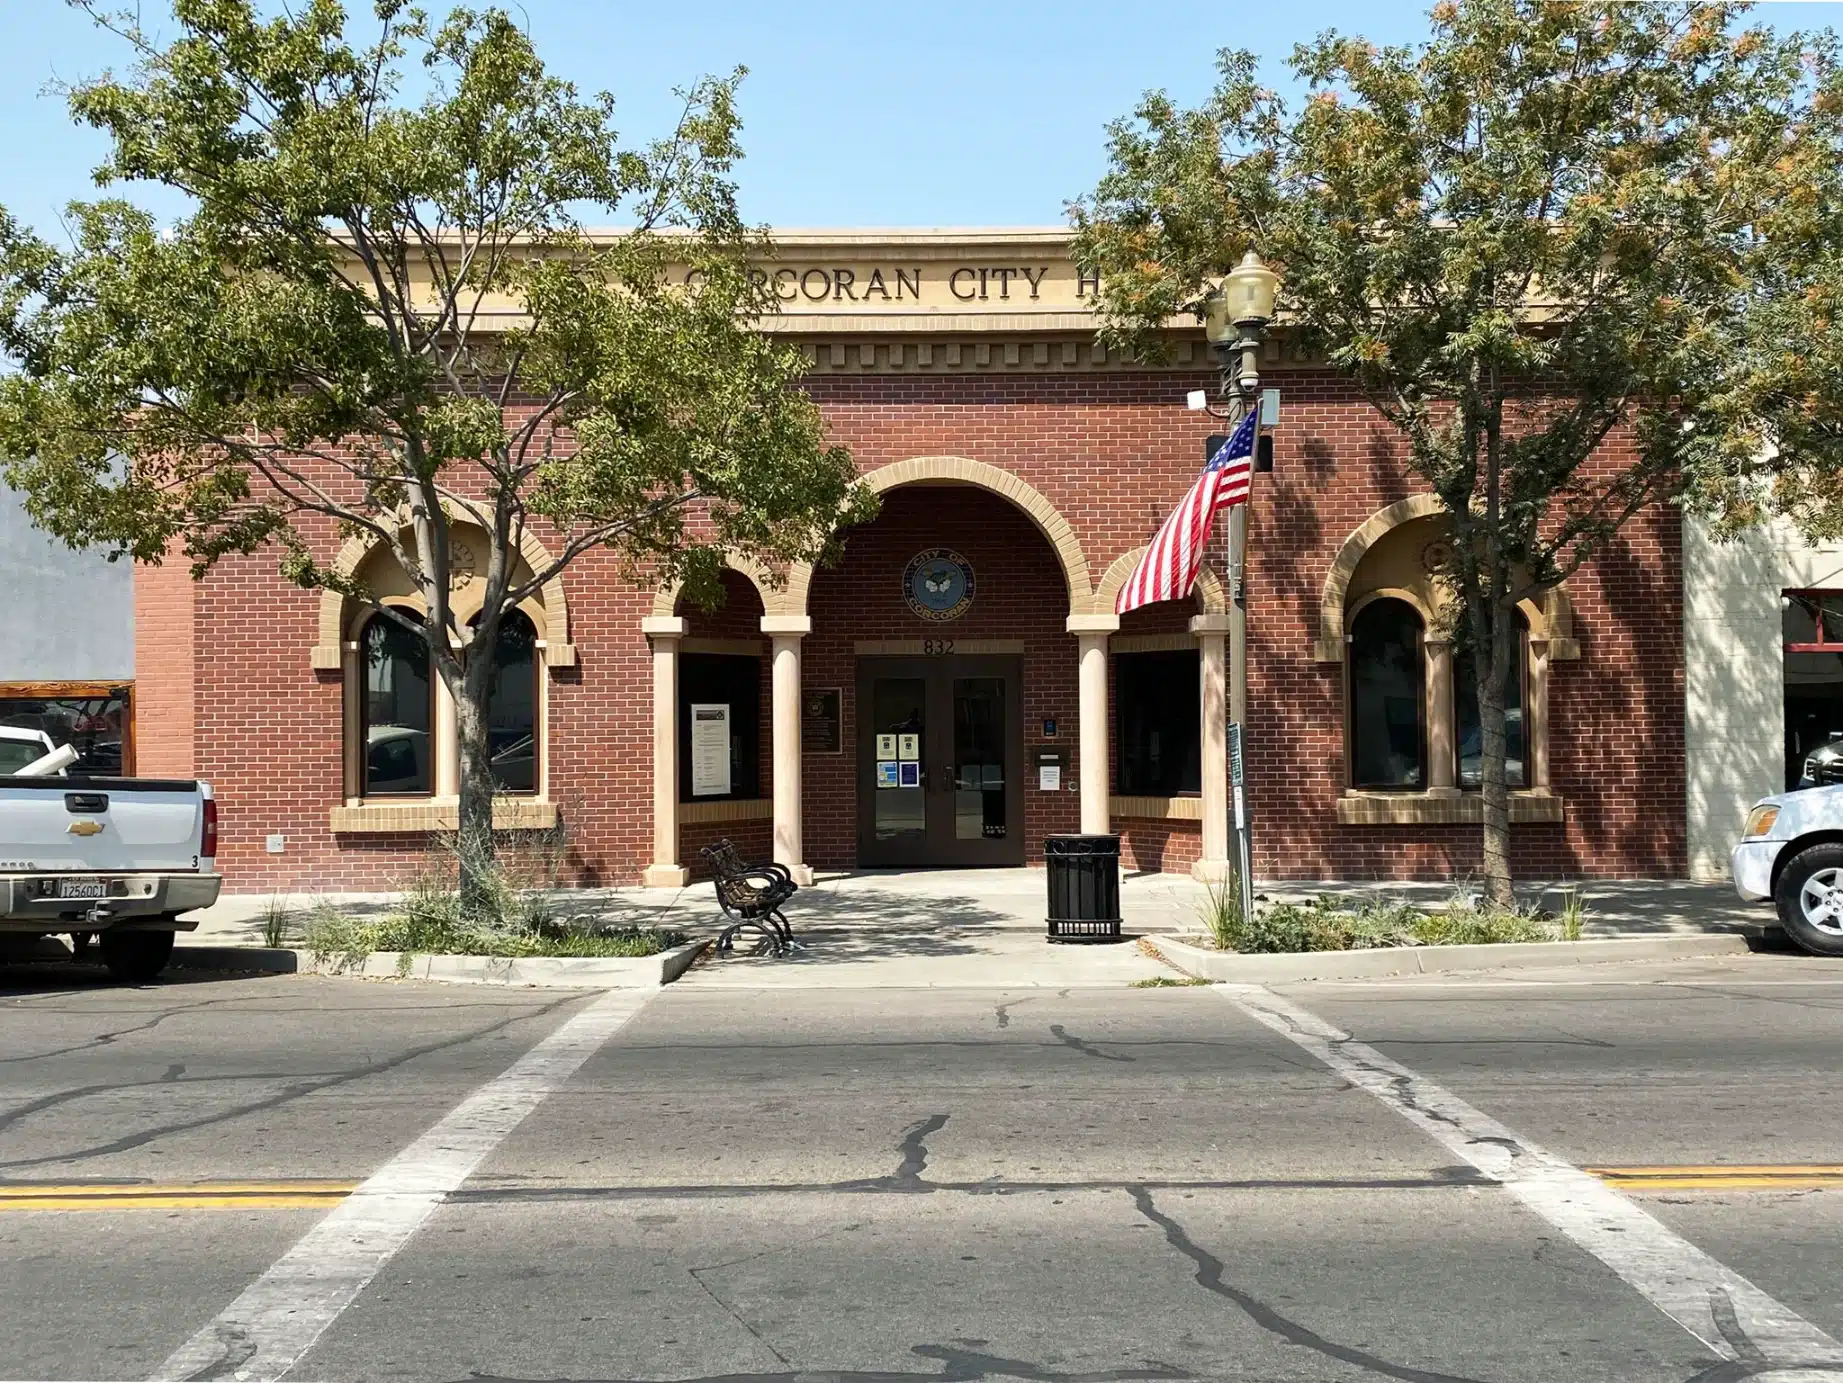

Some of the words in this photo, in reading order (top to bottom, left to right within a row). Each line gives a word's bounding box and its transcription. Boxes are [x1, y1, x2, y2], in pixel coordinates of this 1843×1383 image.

[684, 268, 921, 300] CRCORAN
[949, 267, 1049, 300] CITY
[913, 550, 940, 567] CITY
[949, 553, 968, 566] OF
[909, 597, 970, 620] CORCORAN
[924, 639, 955, 656] 832
[191, 854, 199, 868] 3
